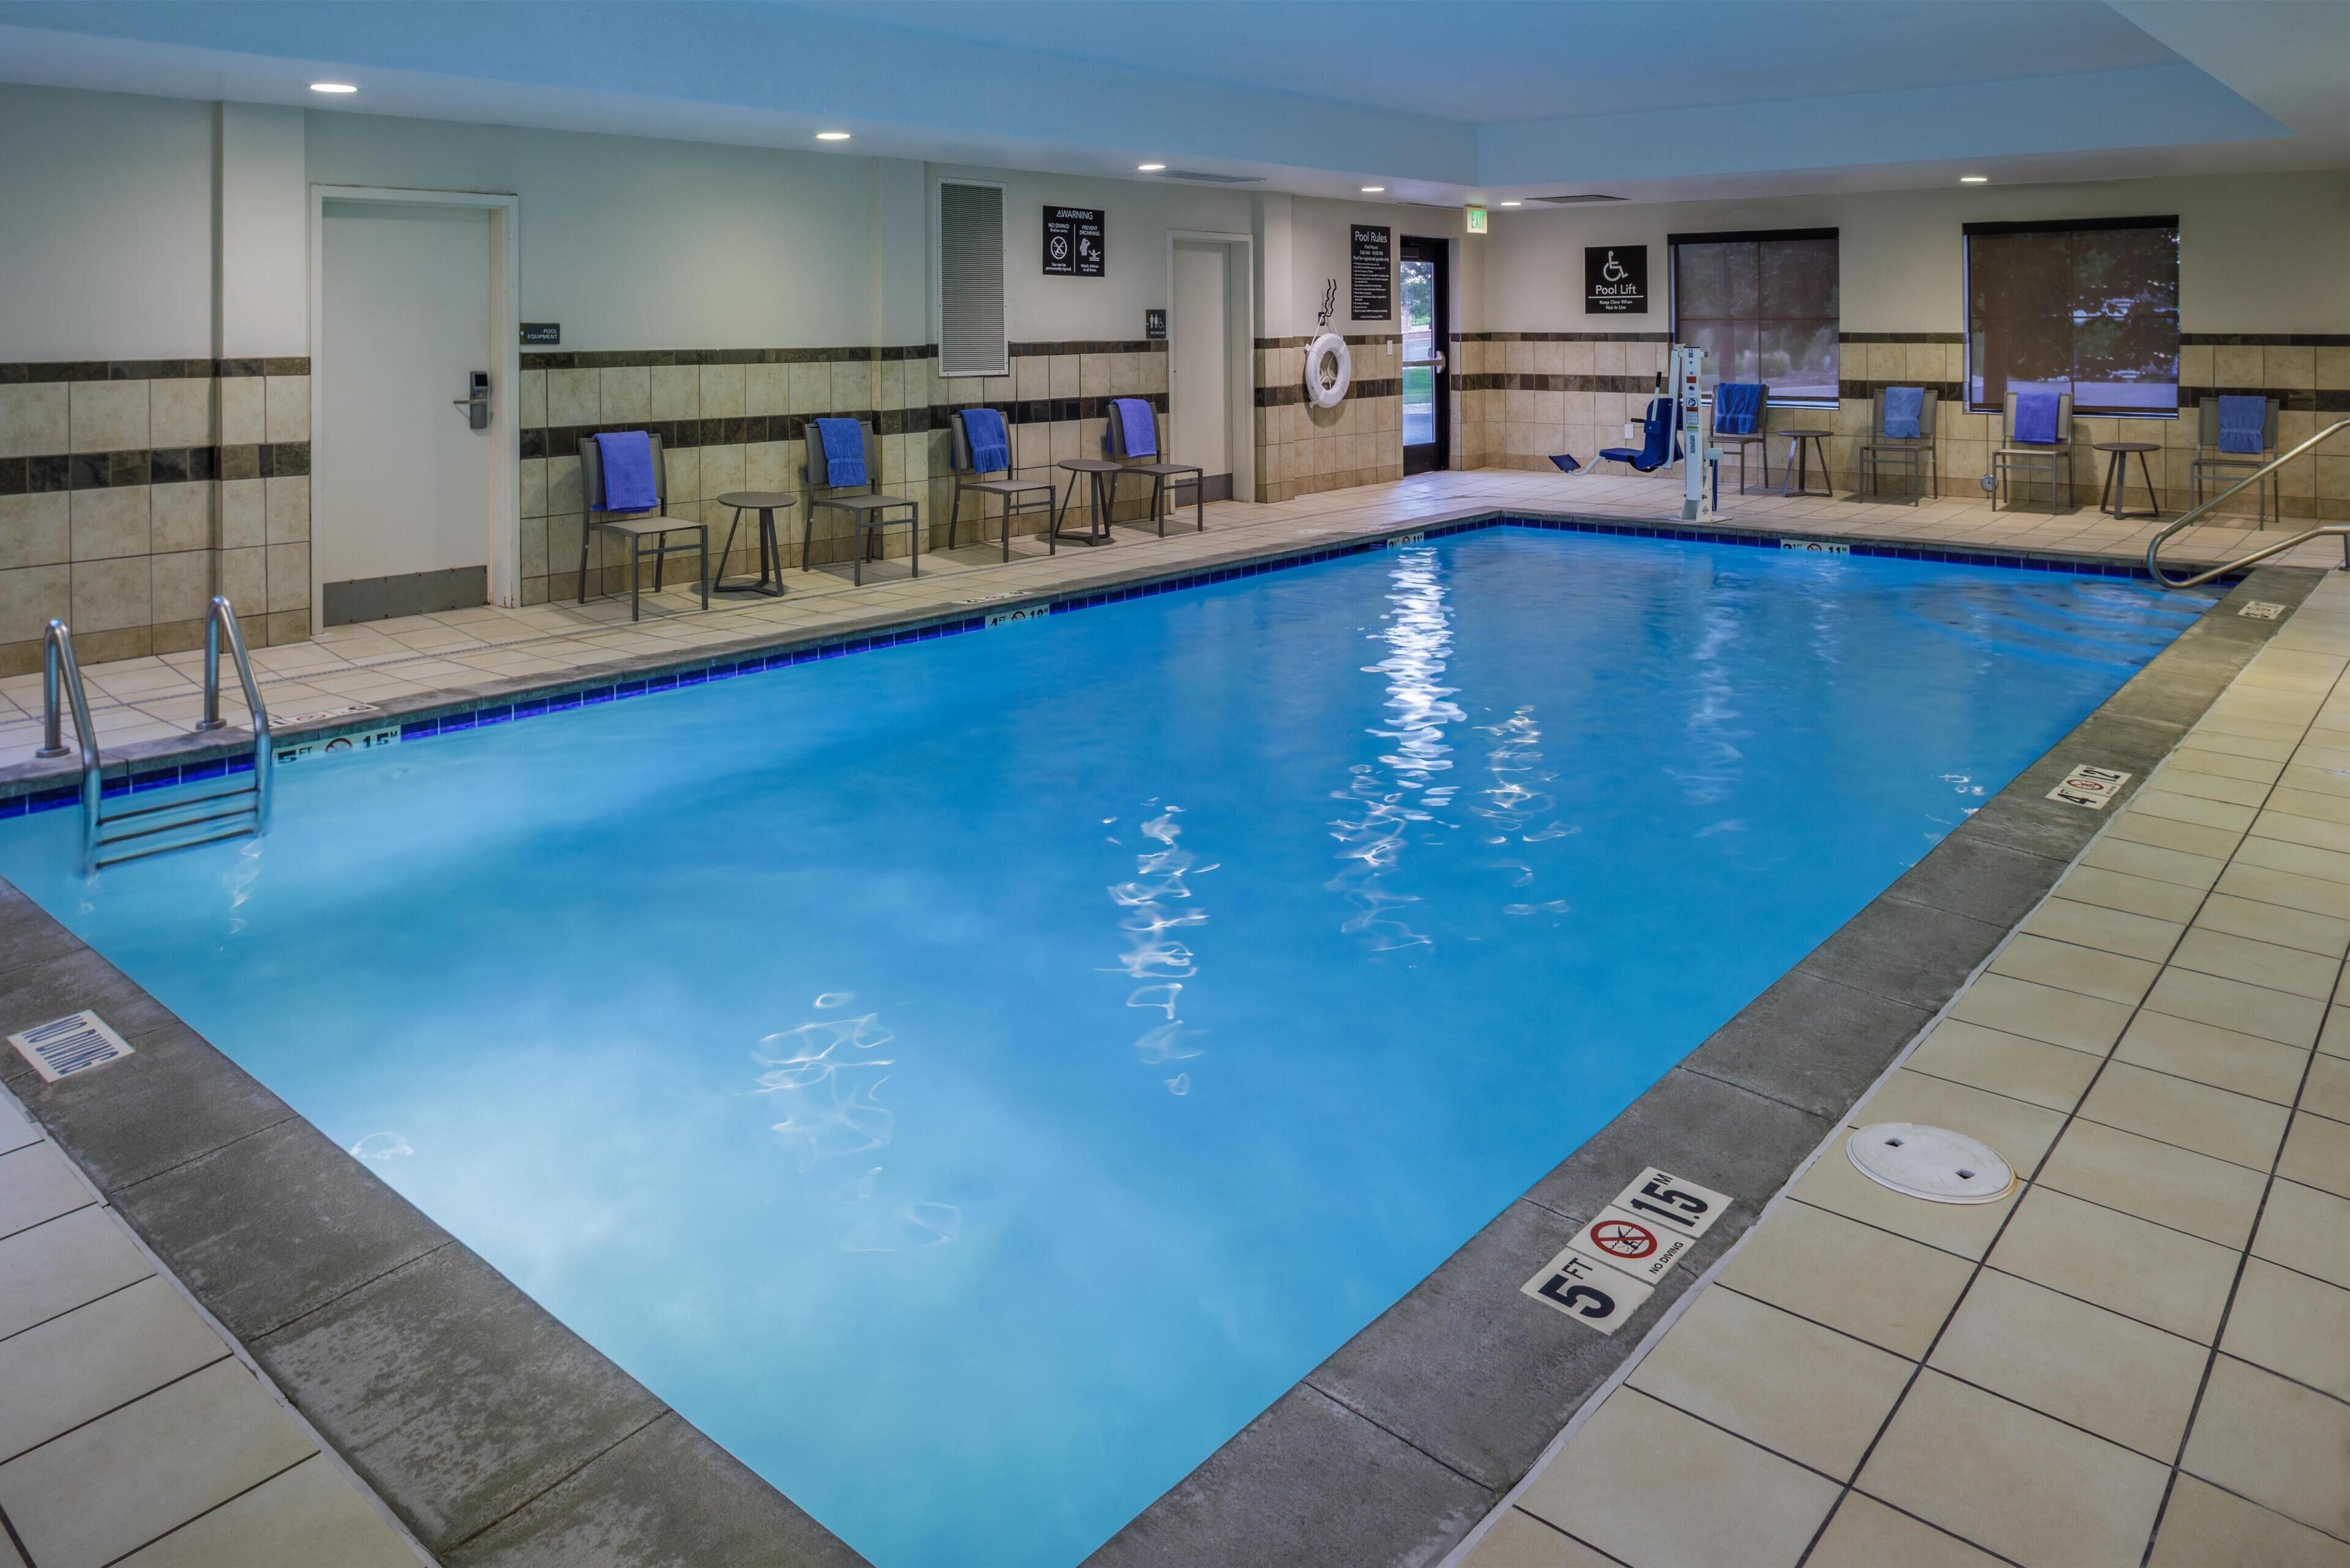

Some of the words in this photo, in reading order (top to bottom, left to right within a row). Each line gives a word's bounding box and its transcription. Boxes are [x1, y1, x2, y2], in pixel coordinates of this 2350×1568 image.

[1061, 209, 1093, 220] WARNING
[1471, 210, 1485, 229] EXIT
[1355, 231, 1369, 242] Pool
[1371, 232, 1387, 243] Rules
[1595, 284, 1617, 295] Pool
[1621, 283, 1637, 294] Lift
[278, 749, 298, 764] 5
[299, 746, 313, 756] FT
[2057, 793, 2097, 805] 4
[21, 1014, 89, 1043] NO
[34, 1028, 119, 1075] DIVING
[1653, 1173, 1674, 1185] M
[1630, 1181, 1709, 1228] 1.5
[1648, 1261, 1663, 1275] NO
[1660, 1241, 1685, 1267] DIVING
[1561, 1257, 1594, 1280] FT
[1537, 1273, 1616, 1319] 5
